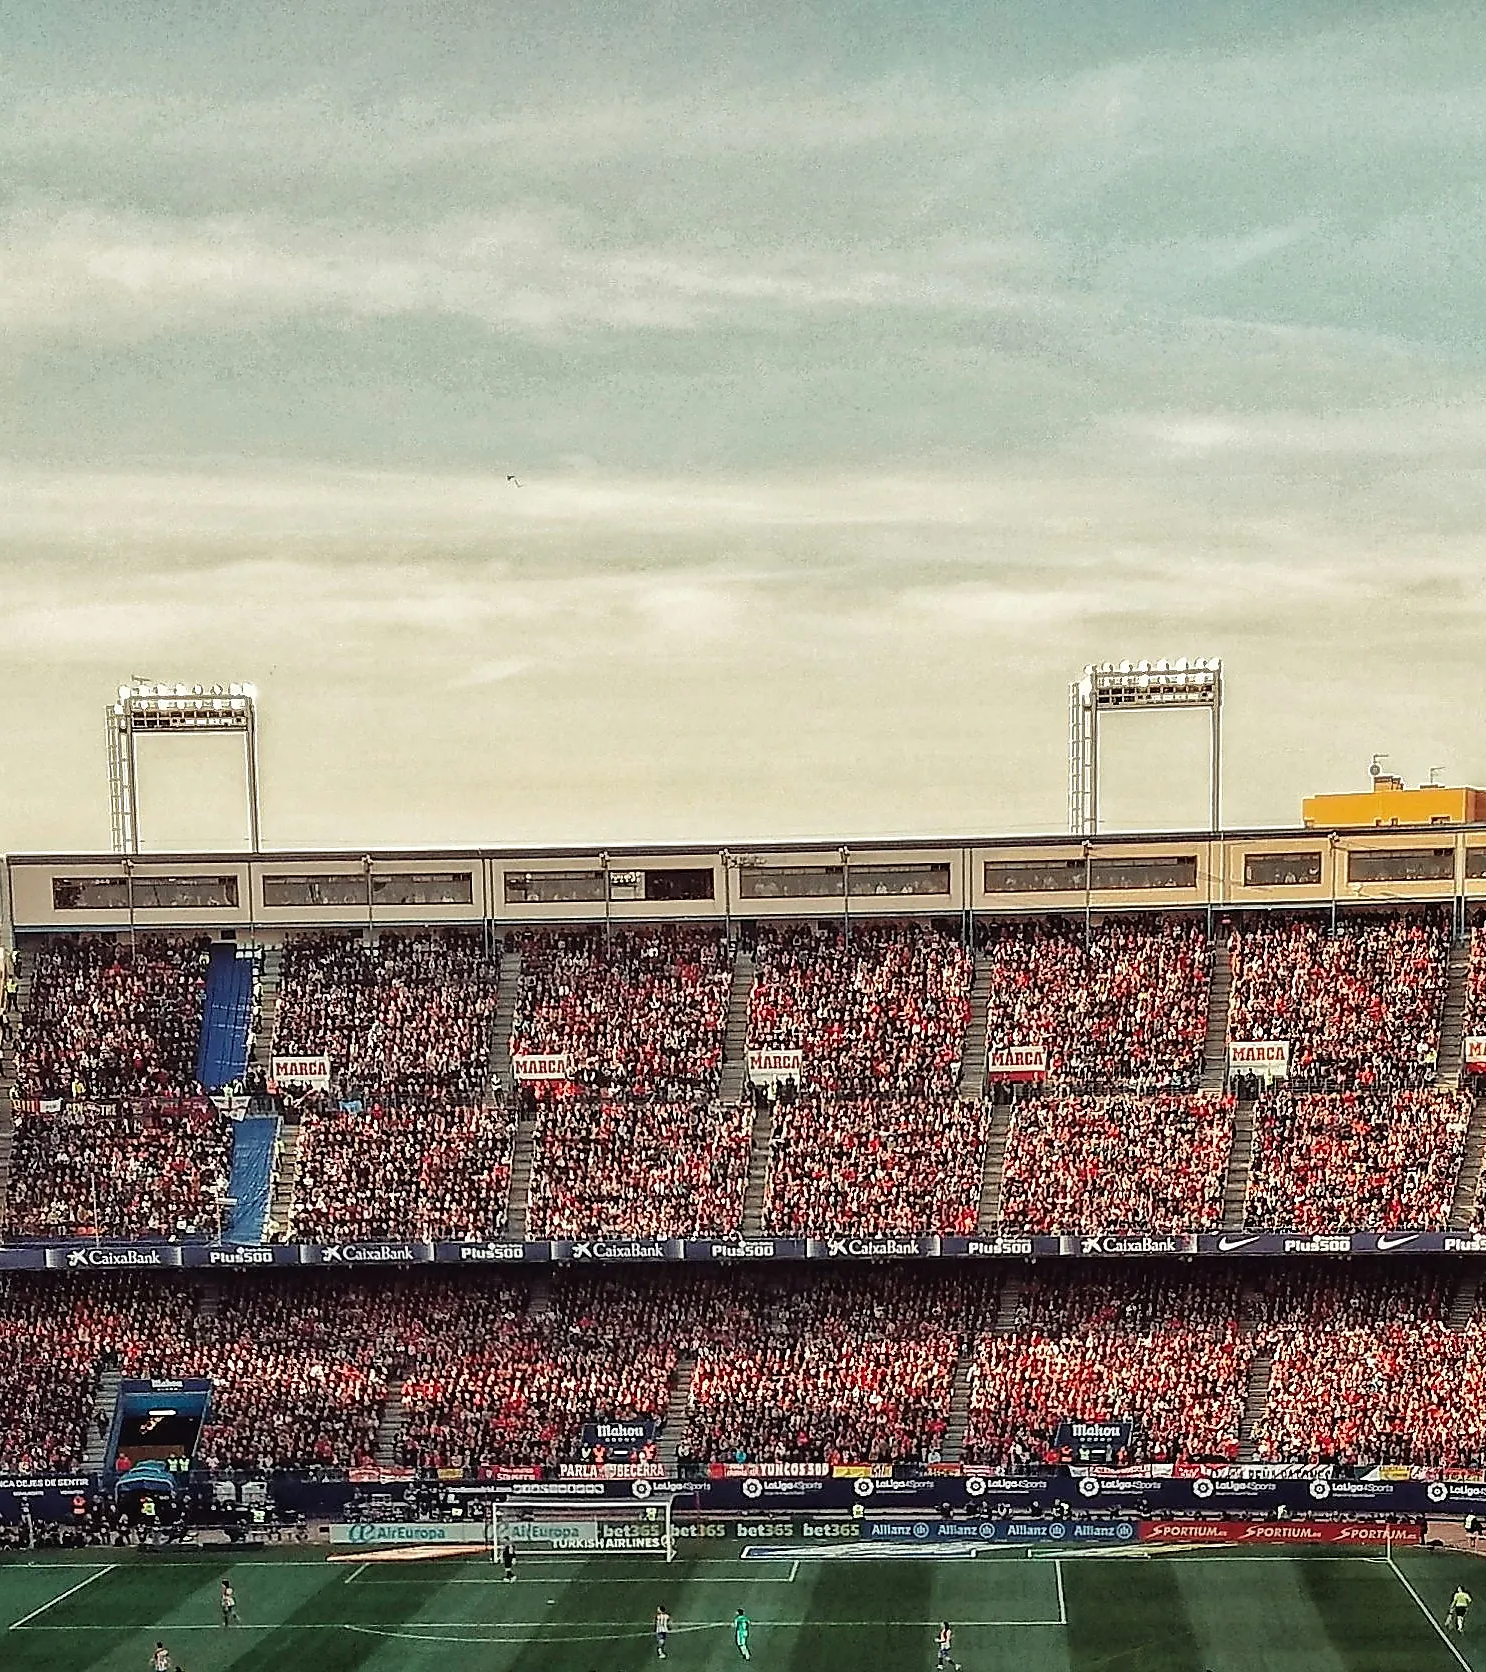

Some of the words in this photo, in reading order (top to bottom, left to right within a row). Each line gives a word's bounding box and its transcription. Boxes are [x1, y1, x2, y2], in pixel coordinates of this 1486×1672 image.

[993, 1051, 1043, 1066] MARCA
[1233, 1046, 1285, 1061] MARCA
[276, 1062, 325, 1076] MARCA
[516, 1060, 563, 1074] MARCA
[752, 1056, 799, 1070] MARCA
[593, 1242, 664, 1258] CaixaBank
[712, 1243, 773, 1257] Plus500
[849, 1239, 920, 1256] CaixaBank
[968, 1240, 1031, 1255] Plus500
[1103, 1237, 1175, 1253] CaixaBank
[1284, 1237, 1350, 1252] Plus500
[89, 1250, 161, 1266] CaixaBank
[211, 1249, 273, 1264] Plus500
[342, 1246, 414, 1262] CaixaBank
[461, 1245, 523, 1259] Plus500
[597, 1424, 643, 1437] Mahou
[1073, 1423, 1121, 1437] Mahou
[559, 1464, 598, 1478] PARLA
[16, 1479, 43, 1488] DEJES
[45, 1479, 56, 1487] DE
[58, 1478, 89, 1487] SENTIR
[377, 1526, 445, 1540] AirEuropa
[603, 1524, 659, 1537] bet365
[671, 1524, 725, 1537] bet365
[737, 1524, 793, 1537] bet365
[803, 1523, 860, 1537] bet365
[872, 1524, 912, 1536] Allianz
[938, 1524, 977, 1536] Allianz
[1008, 1524, 1047, 1536] Allianz
[1074, 1525, 1116, 1537] Allianz
[552, 1538, 604, 1549] TURKISH
[605, 1537, 660, 1548] AIRLINES
